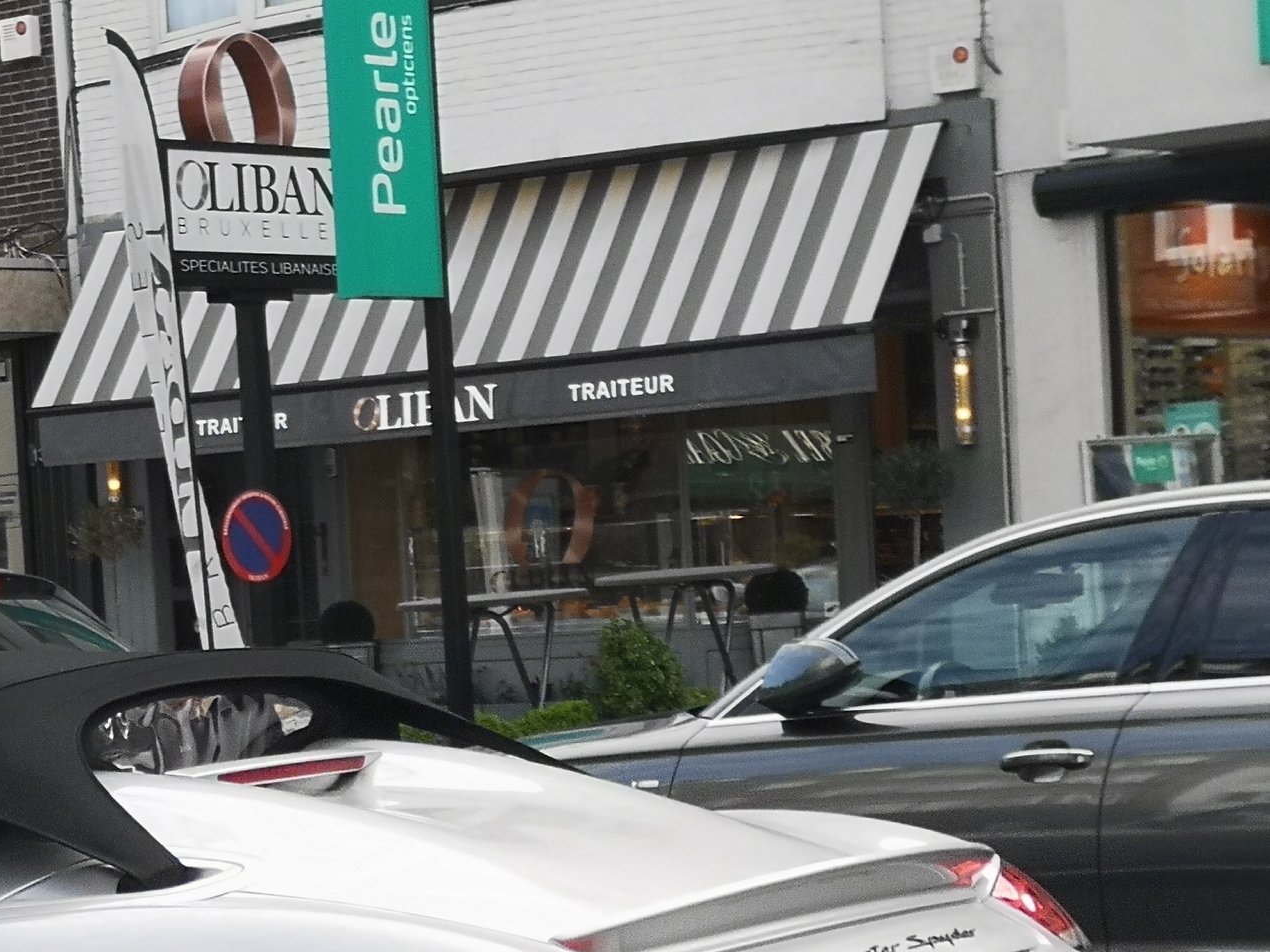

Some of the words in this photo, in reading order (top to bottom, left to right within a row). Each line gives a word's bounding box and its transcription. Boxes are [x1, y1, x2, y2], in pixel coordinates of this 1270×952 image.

[401, 15, 419, 115] opticiens
[364, 11, 407, 214] Pearle
[177, 217, 328, 240] BRUXELLE
[180, 259, 268, 274] SPECIALITES
[272, 262, 338, 277] LIBANAISE
[195, 412, 288, 436] TRAIR
[568, 374, 675, 402] TRAITEUR
[905, 928, 977, 950] Spyder
